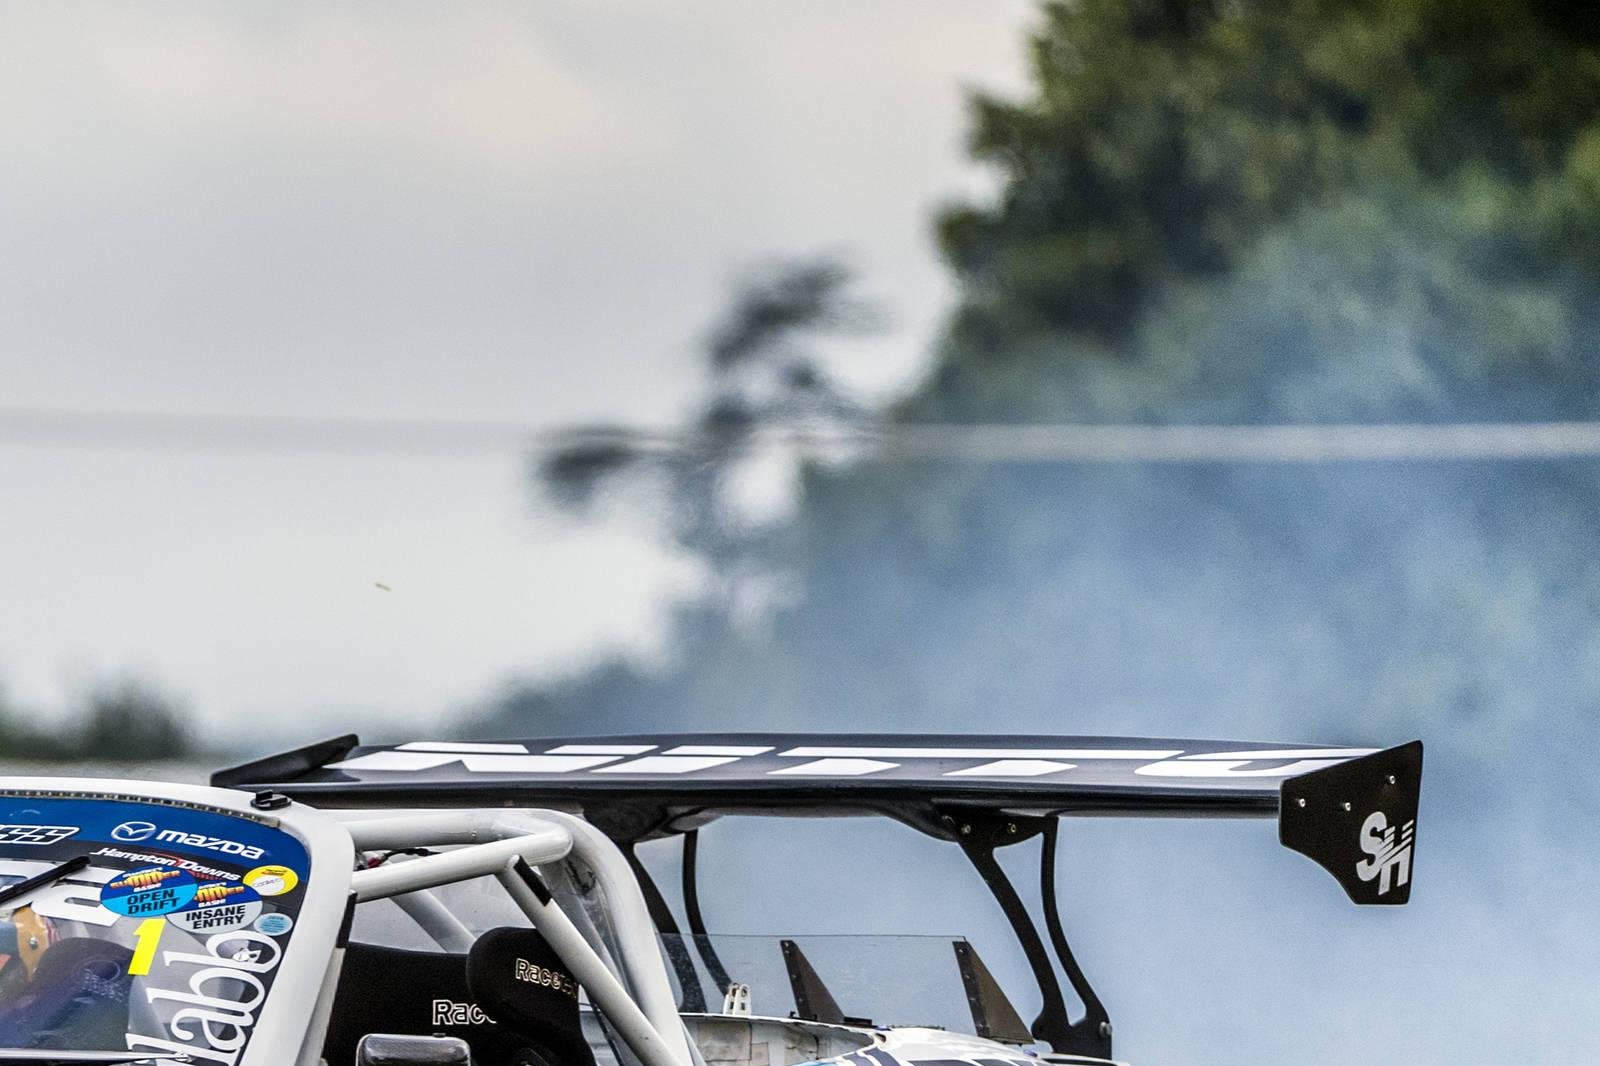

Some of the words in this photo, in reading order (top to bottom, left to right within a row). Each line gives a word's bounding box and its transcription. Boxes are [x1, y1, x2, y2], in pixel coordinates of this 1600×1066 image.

[155, 828, 266, 860] mazda
[90, 847, 178, 867] Hampton
[177, 859, 242, 881] Downs
[127, 889, 175, 906] OPEN
[127, 898, 181, 915] DRIFT
[186, 905, 246, 922] INSANE
[192, 914, 245, 930] ENTRY
